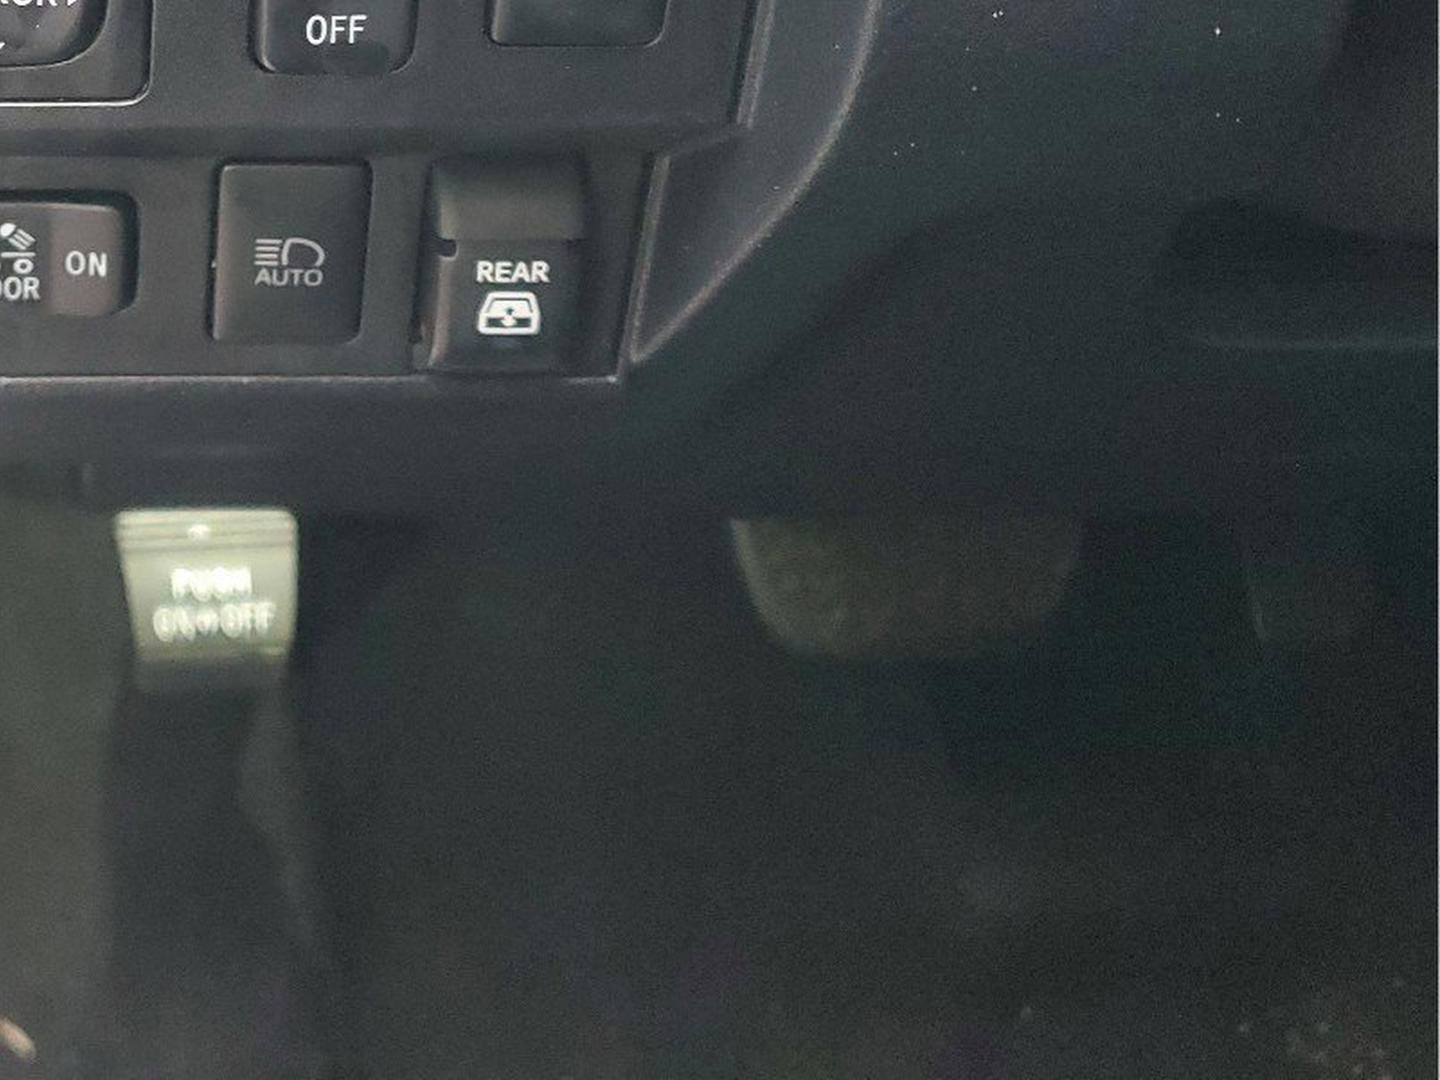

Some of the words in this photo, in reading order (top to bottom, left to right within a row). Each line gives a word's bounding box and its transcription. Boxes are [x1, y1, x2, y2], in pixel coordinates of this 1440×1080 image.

[305, 14, 368, 46] OFF
[64, 250, 108, 278] ON
[254, 264, 324, 287] AUTO
[476, 260, 550, 284] REAR
